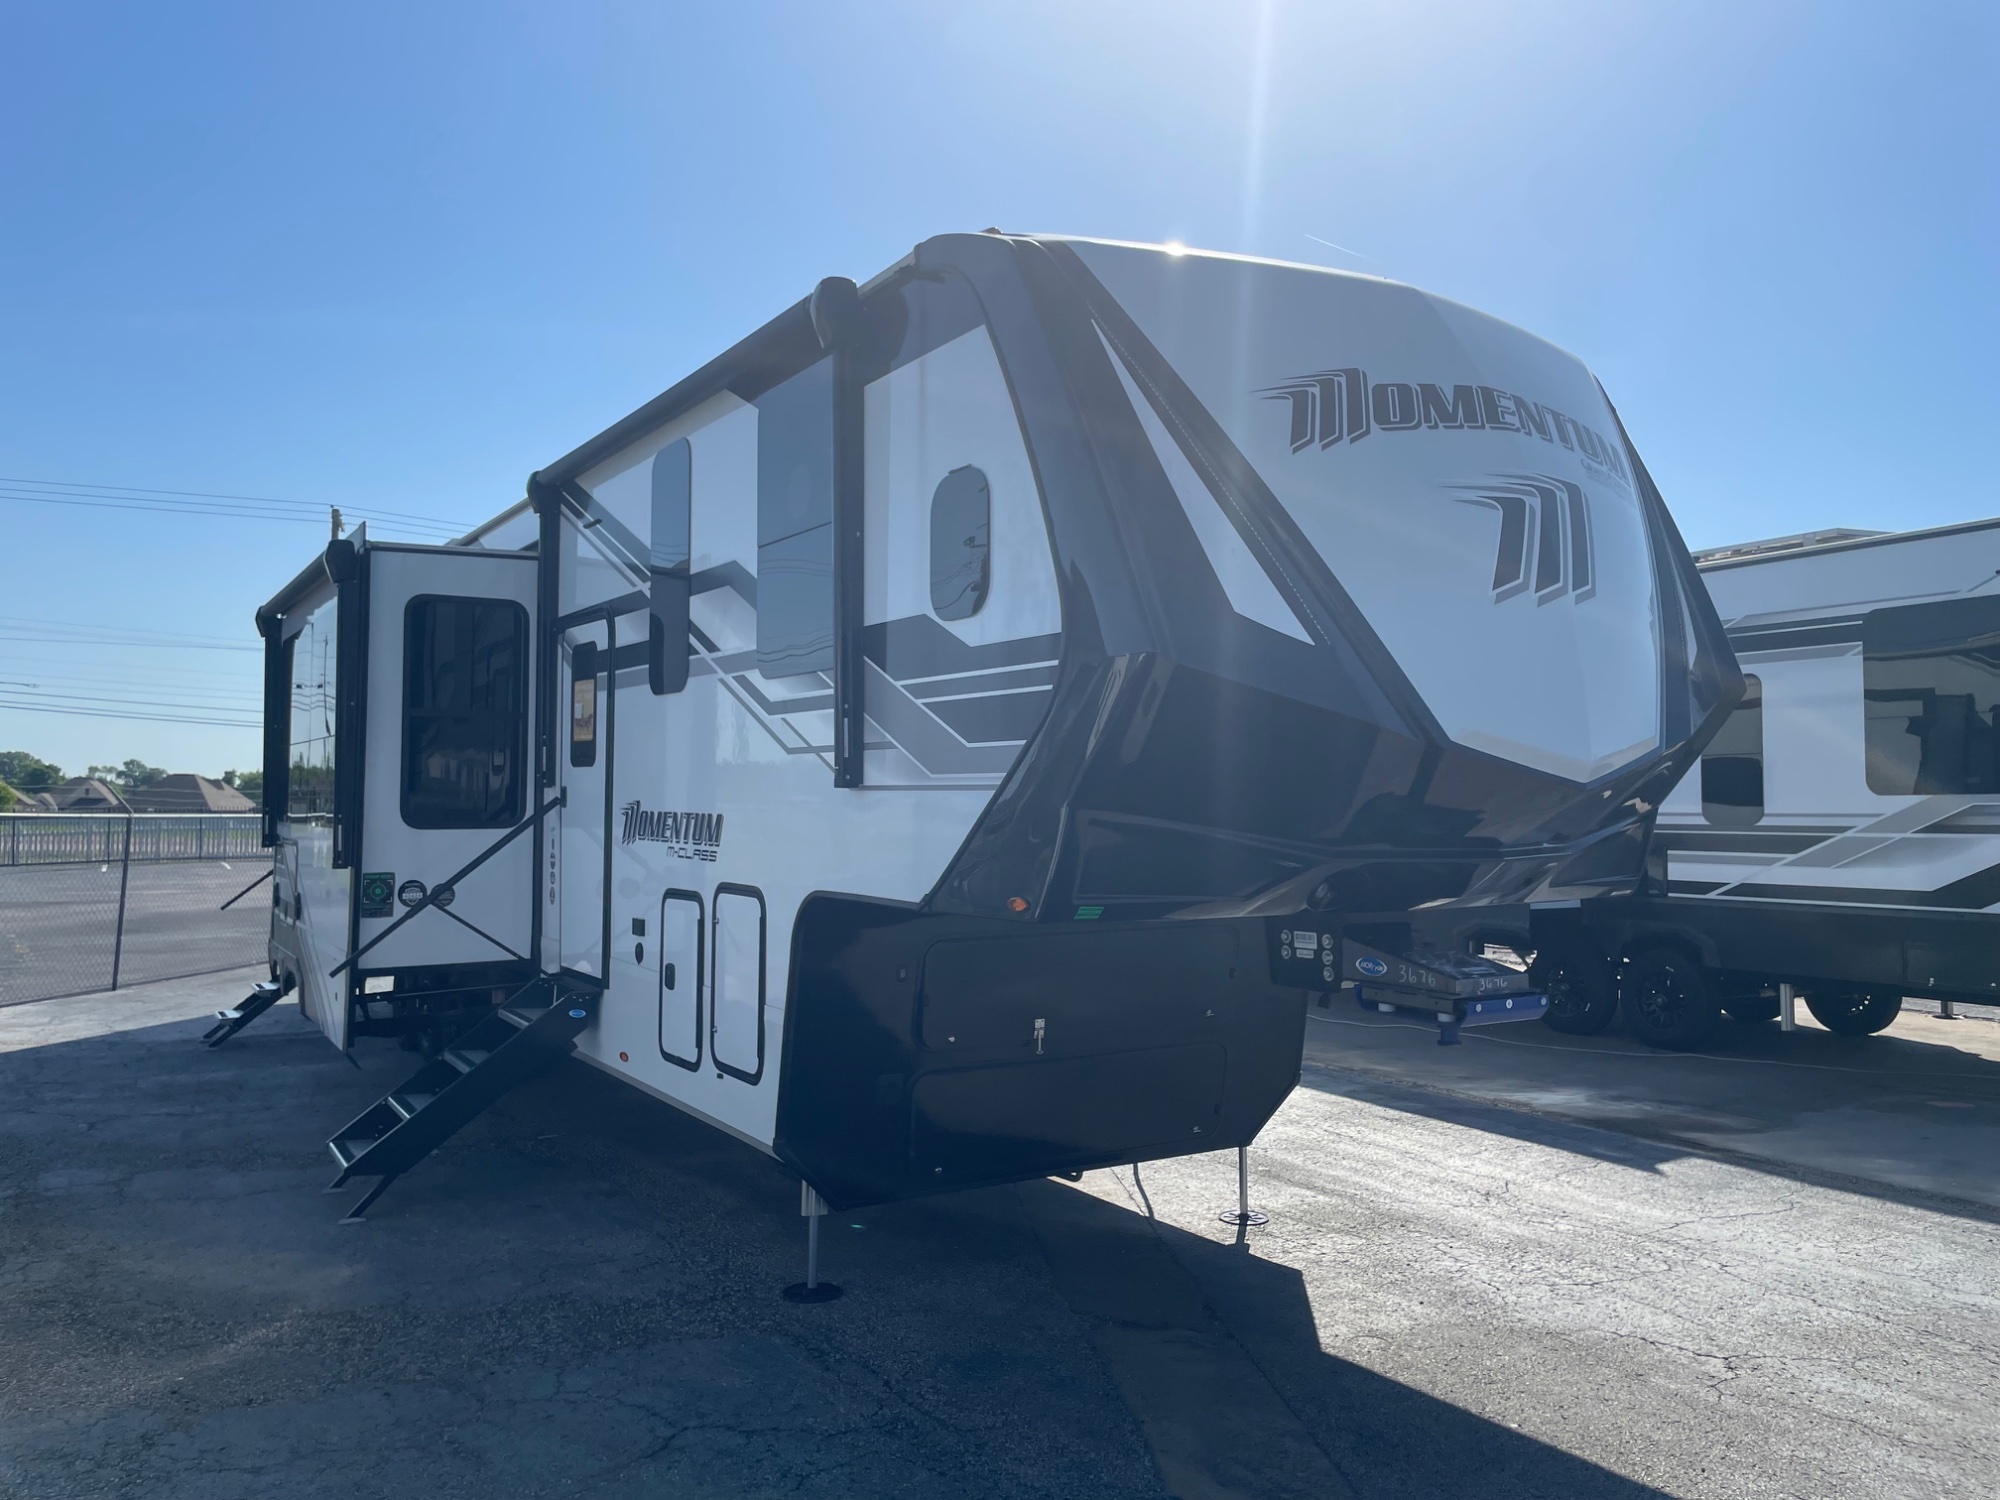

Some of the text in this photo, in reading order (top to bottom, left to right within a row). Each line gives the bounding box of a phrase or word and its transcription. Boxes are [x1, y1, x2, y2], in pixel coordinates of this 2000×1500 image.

[1250, 367, 1632, 488] MOMENTUM
[620, 800, 724, 847] MOMENTUM
[1398, 964, 1436, 987] 3676
[1478, 978, 1508, 991] 3676
